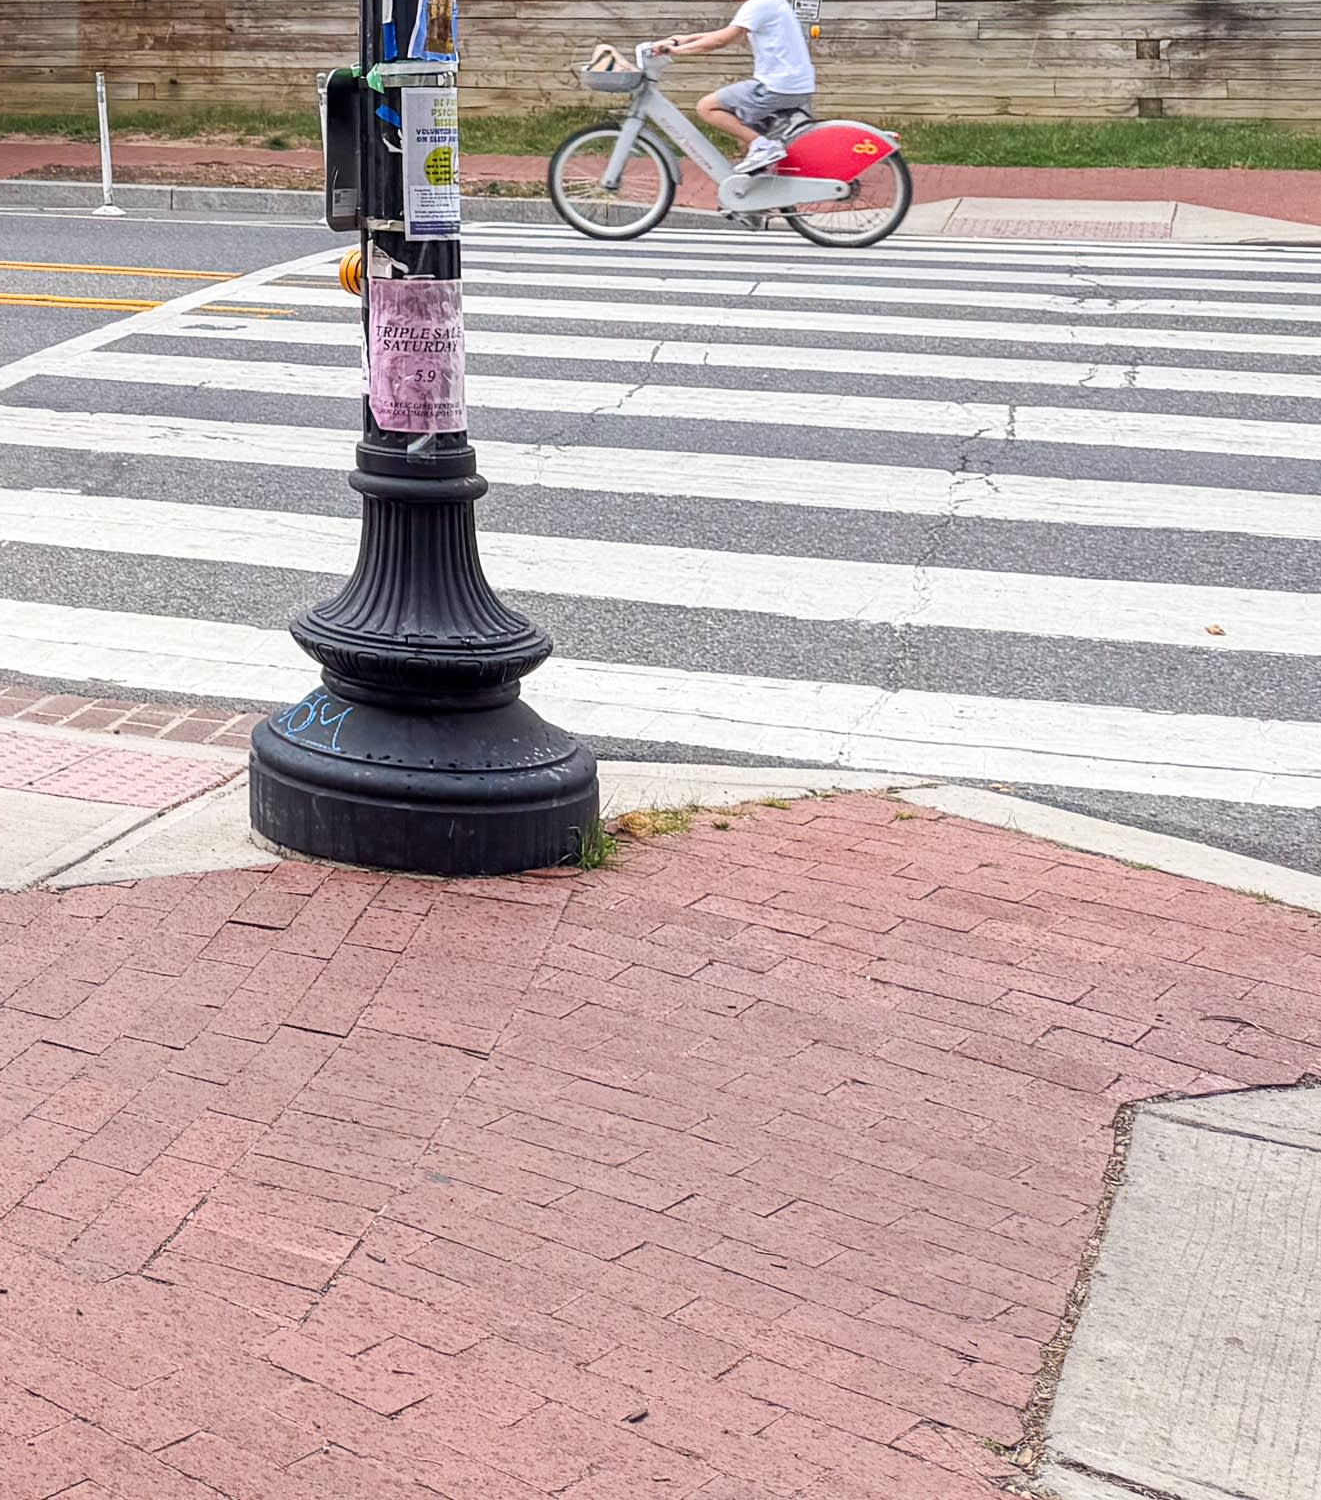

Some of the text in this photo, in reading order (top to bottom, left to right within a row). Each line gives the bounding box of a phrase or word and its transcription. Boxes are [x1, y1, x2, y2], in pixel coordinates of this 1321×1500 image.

[376, 326, 461, 340] TRIPLE SALE
[383, 339, 457, 353] SATURDAY
[414, 369, 436, 383] 5.9
